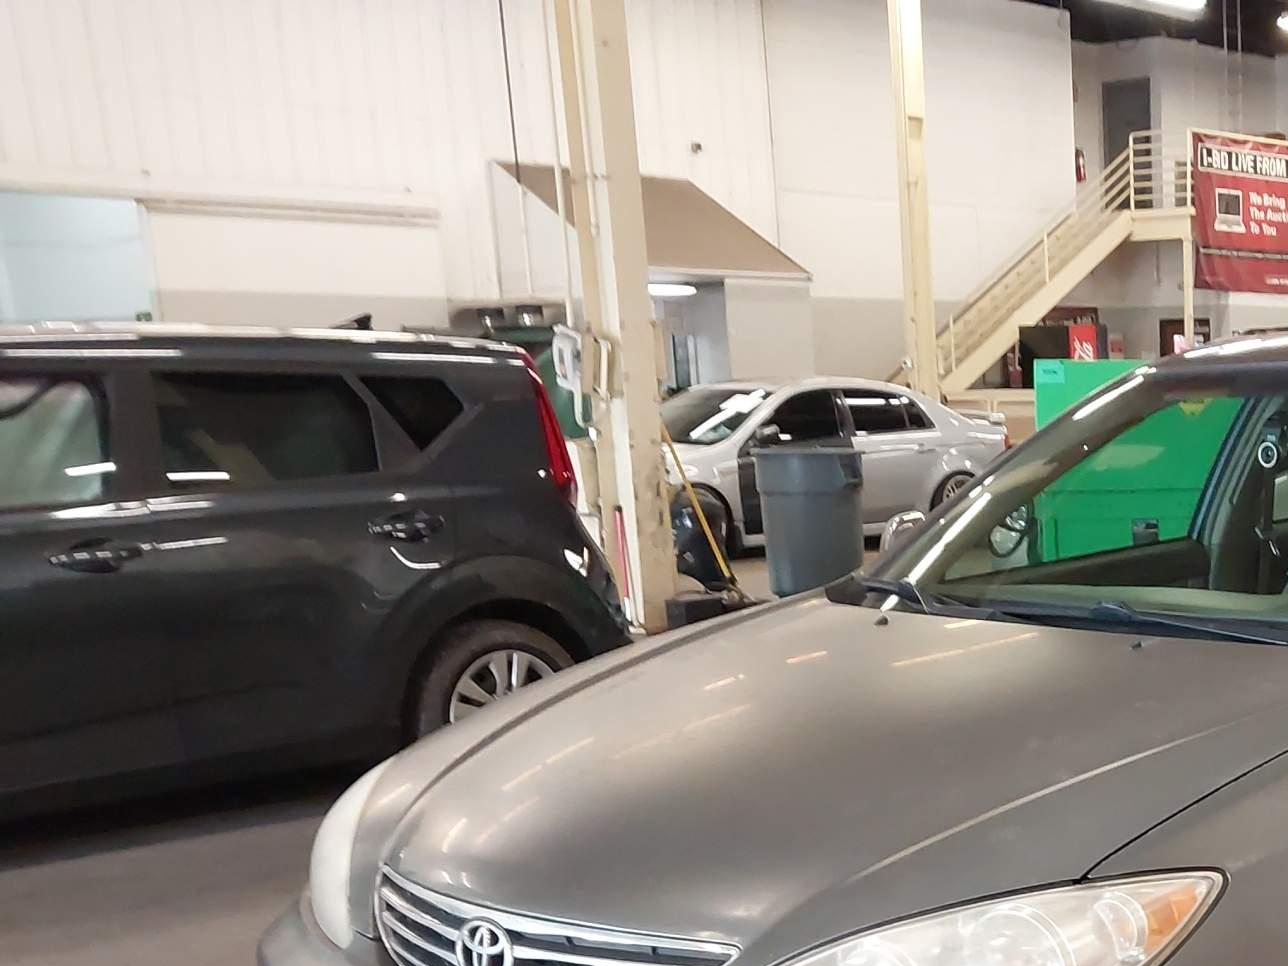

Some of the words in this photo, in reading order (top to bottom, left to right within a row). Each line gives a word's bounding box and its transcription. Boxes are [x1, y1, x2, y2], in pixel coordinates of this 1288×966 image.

[1231, 151, 1255, 174] LIVE
[1256, 154, 1287, 178] FROM
[1249, 192, 1263, 204] We
[1263, 193, 1286, 210] Bring
[1249, 206, 1265, 220] The
[1249, 222, 1260, 235] To
[1262, 223, 1277, 236] You
